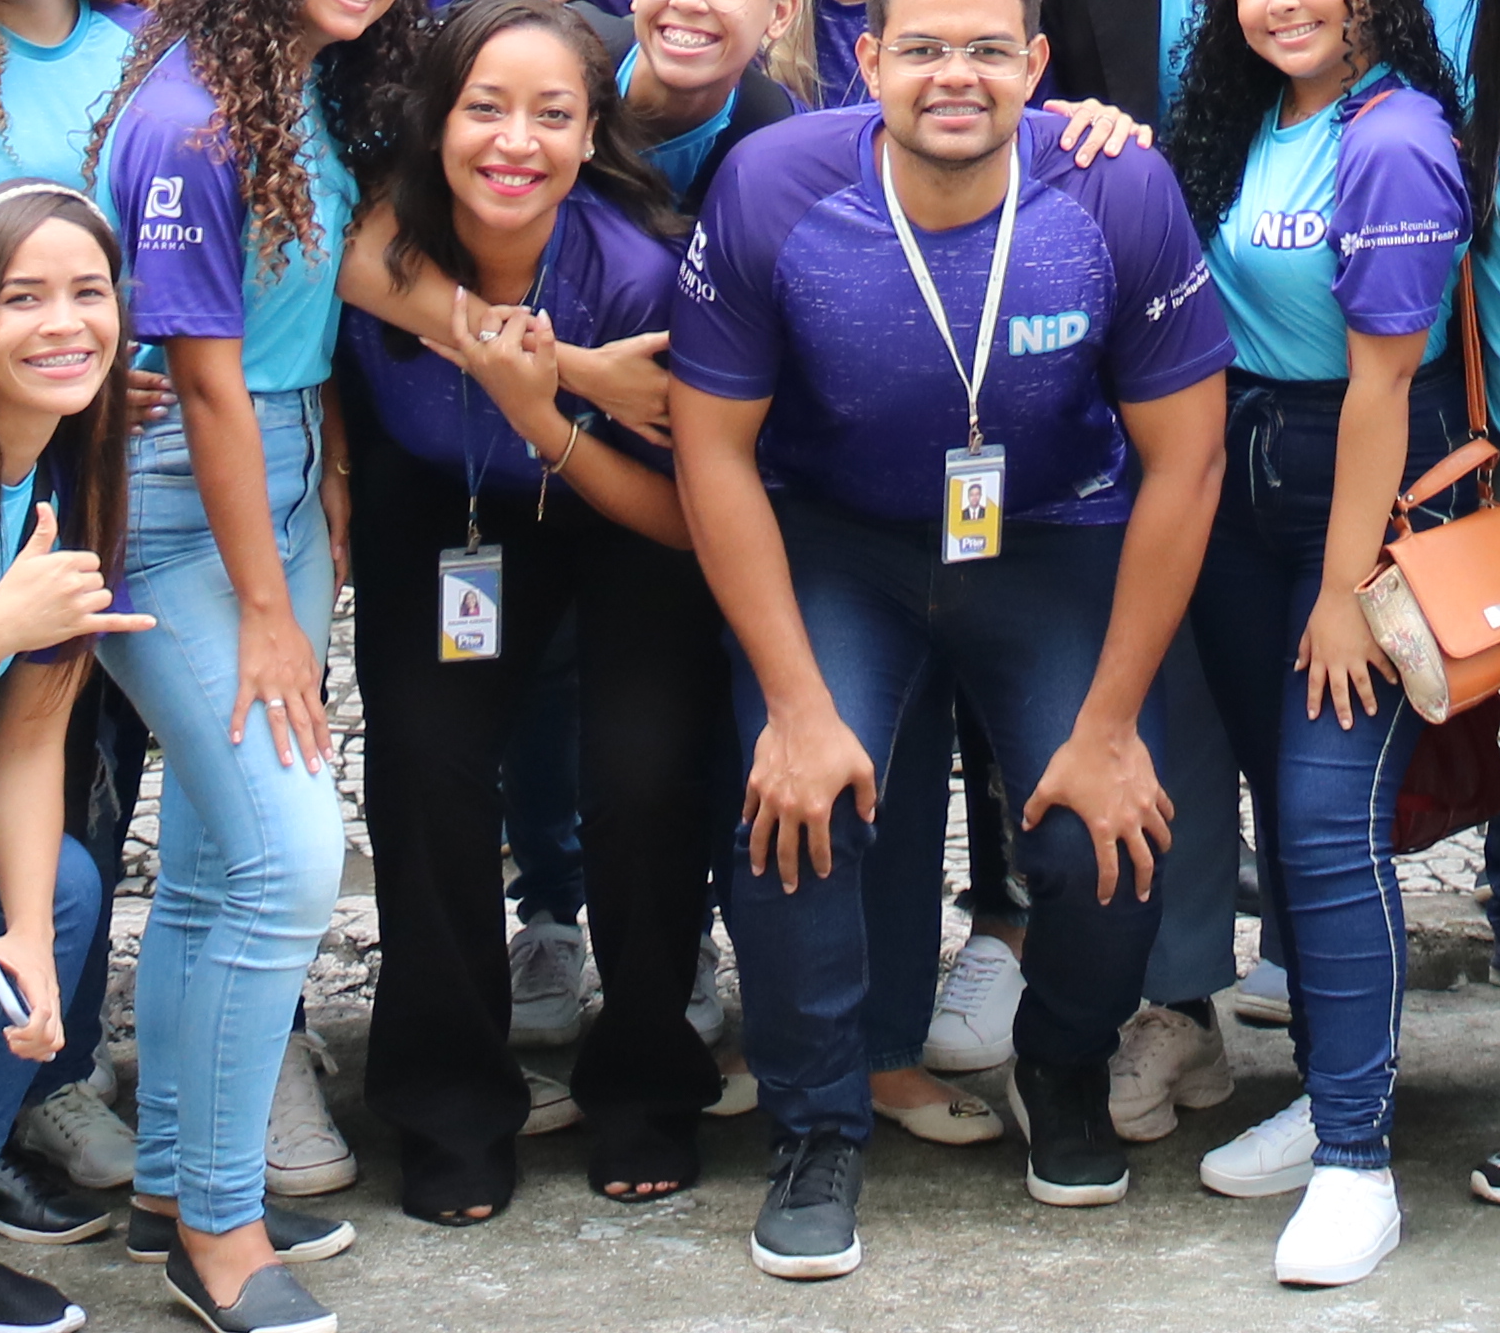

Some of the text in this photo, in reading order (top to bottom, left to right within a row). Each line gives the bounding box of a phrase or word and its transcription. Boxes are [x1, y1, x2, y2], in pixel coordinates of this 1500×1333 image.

[1251, 210, 1328, 250] NiD
[1355, 231, 1415, 250] Raymundo
[1009, 310, 1089, 356] NiD
